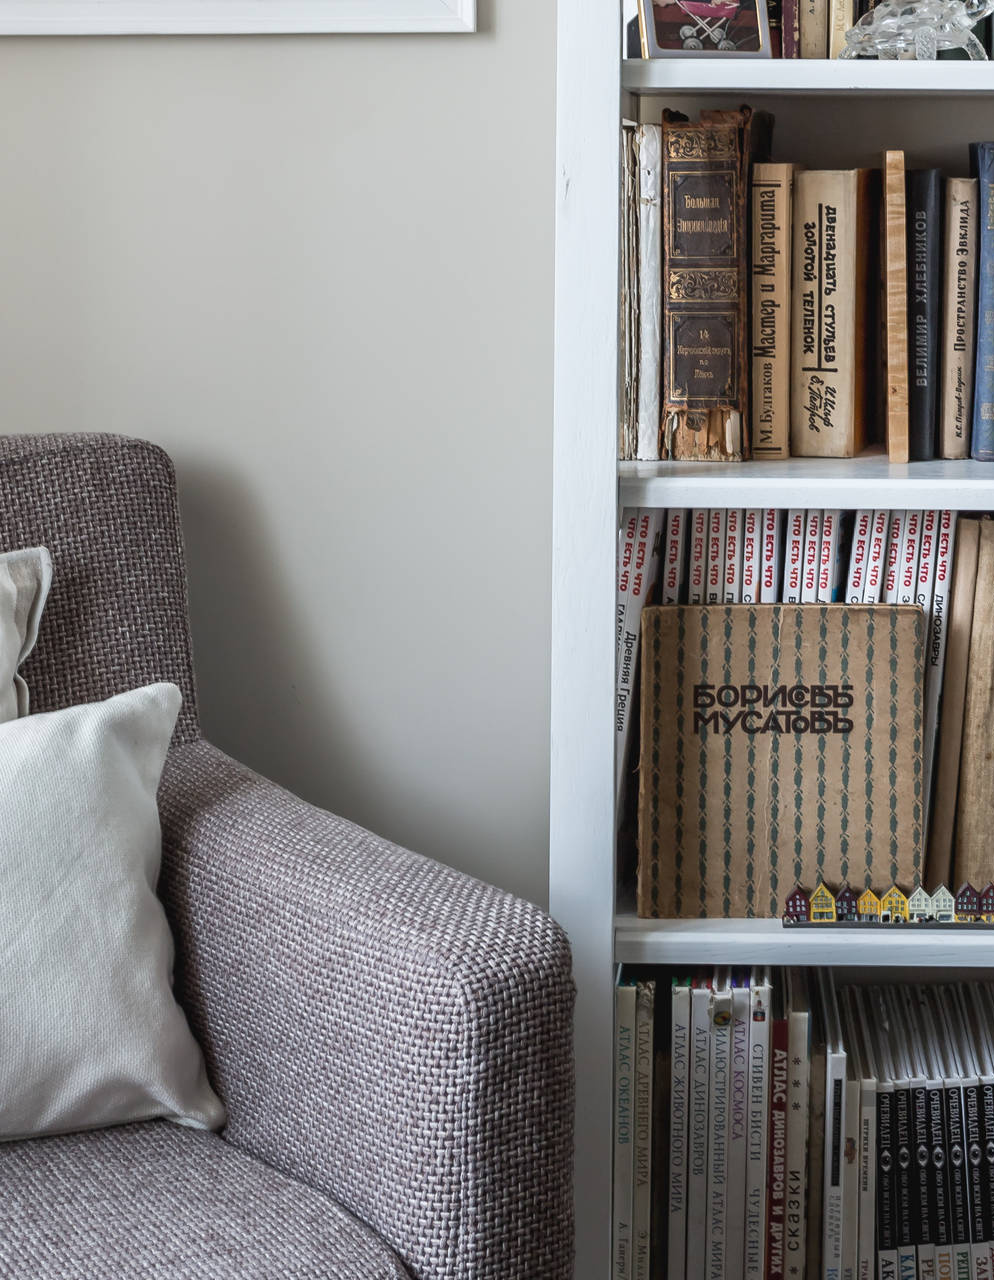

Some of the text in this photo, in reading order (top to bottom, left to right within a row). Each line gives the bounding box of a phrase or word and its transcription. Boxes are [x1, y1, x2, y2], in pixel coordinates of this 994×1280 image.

[753, 189, 781, 276] Маргарита
[762, 283, 776, 293] и
[802, 290, 816, 355] ТЕЛЕНОК
[915, 210, 928, 387] ВЕЛИМИР ХЛЕБНИКОВ
[753, 297, 781, 358] Мастер
[823, 303, 836, 363] СТУЛЬЕВ
[623, 542, 633, 567] ЕСТЬ
[626, 518, 635, 539] ЧТО
[631, 515, 649, 596] ЧТО ЕСТЬ ЧТО
[725, 511, 737, 585] ЧТО ЕСТЬ ЧТО
[744, 511, 755, 587] ЧТО ЕСТЬ ЧТО
[765, 533, 775, 562] ЕСТЬ
[788, 514, 802, 589] ЧТО ЕСТЬ ЧТО
[852, 514, 868, 588] ЧТО ЕСТЬ ЧТО
[903, 515, 918, 588] ЧТО ЕСТЬ ЧТО
[938, 532, 949, 558] ЕСТЬ
[619, 570, 630, 592] ЧТО
[764, 565, 774, 588] ЧТО
[937, 558, 947, 581] ЧТО
[931, 594, 944, 667] ДИНОЗАВРЫ
[617, 631, 637, 731] Древняя Греция
[619, 1025, 631, 1072] АТЛАС
[732, 1018, 746, 1140] АТЛАС КОСМОСА
[618, 1076, 630, 1144] ОКЕАНОВ
[637, 1071, 649, 1141] ДРЕВНЕГО
[671, 1023, 686, 1213] АТЛАС ЖИВОТНОГО МИРА
[693, 1026, 707, 1176] АТЛАС ДИНОЗАВРОВ
[915, 1088, 927, 1143] ОЧЕВИДЕЦ
[930, 1090, 942, 1145] ОЧЕВИДЕЦ
[949, 1088, 961, 1143] ОЧЕВИДЕЦ
[636, 1145, 649, 1188] МИРА
[711, 1027, 727, 1280] ИЛЛЮСТРИРОВАННЫЙ АТЛАС МИРА
[748, 1043, 764, 1274] СТИВЕН БИСТИ ЧУДЕСНЫЕ
[770, 1049, 787, 1274] АТЛАС ДИНОЗАВРОВ И ДРУГИХ
